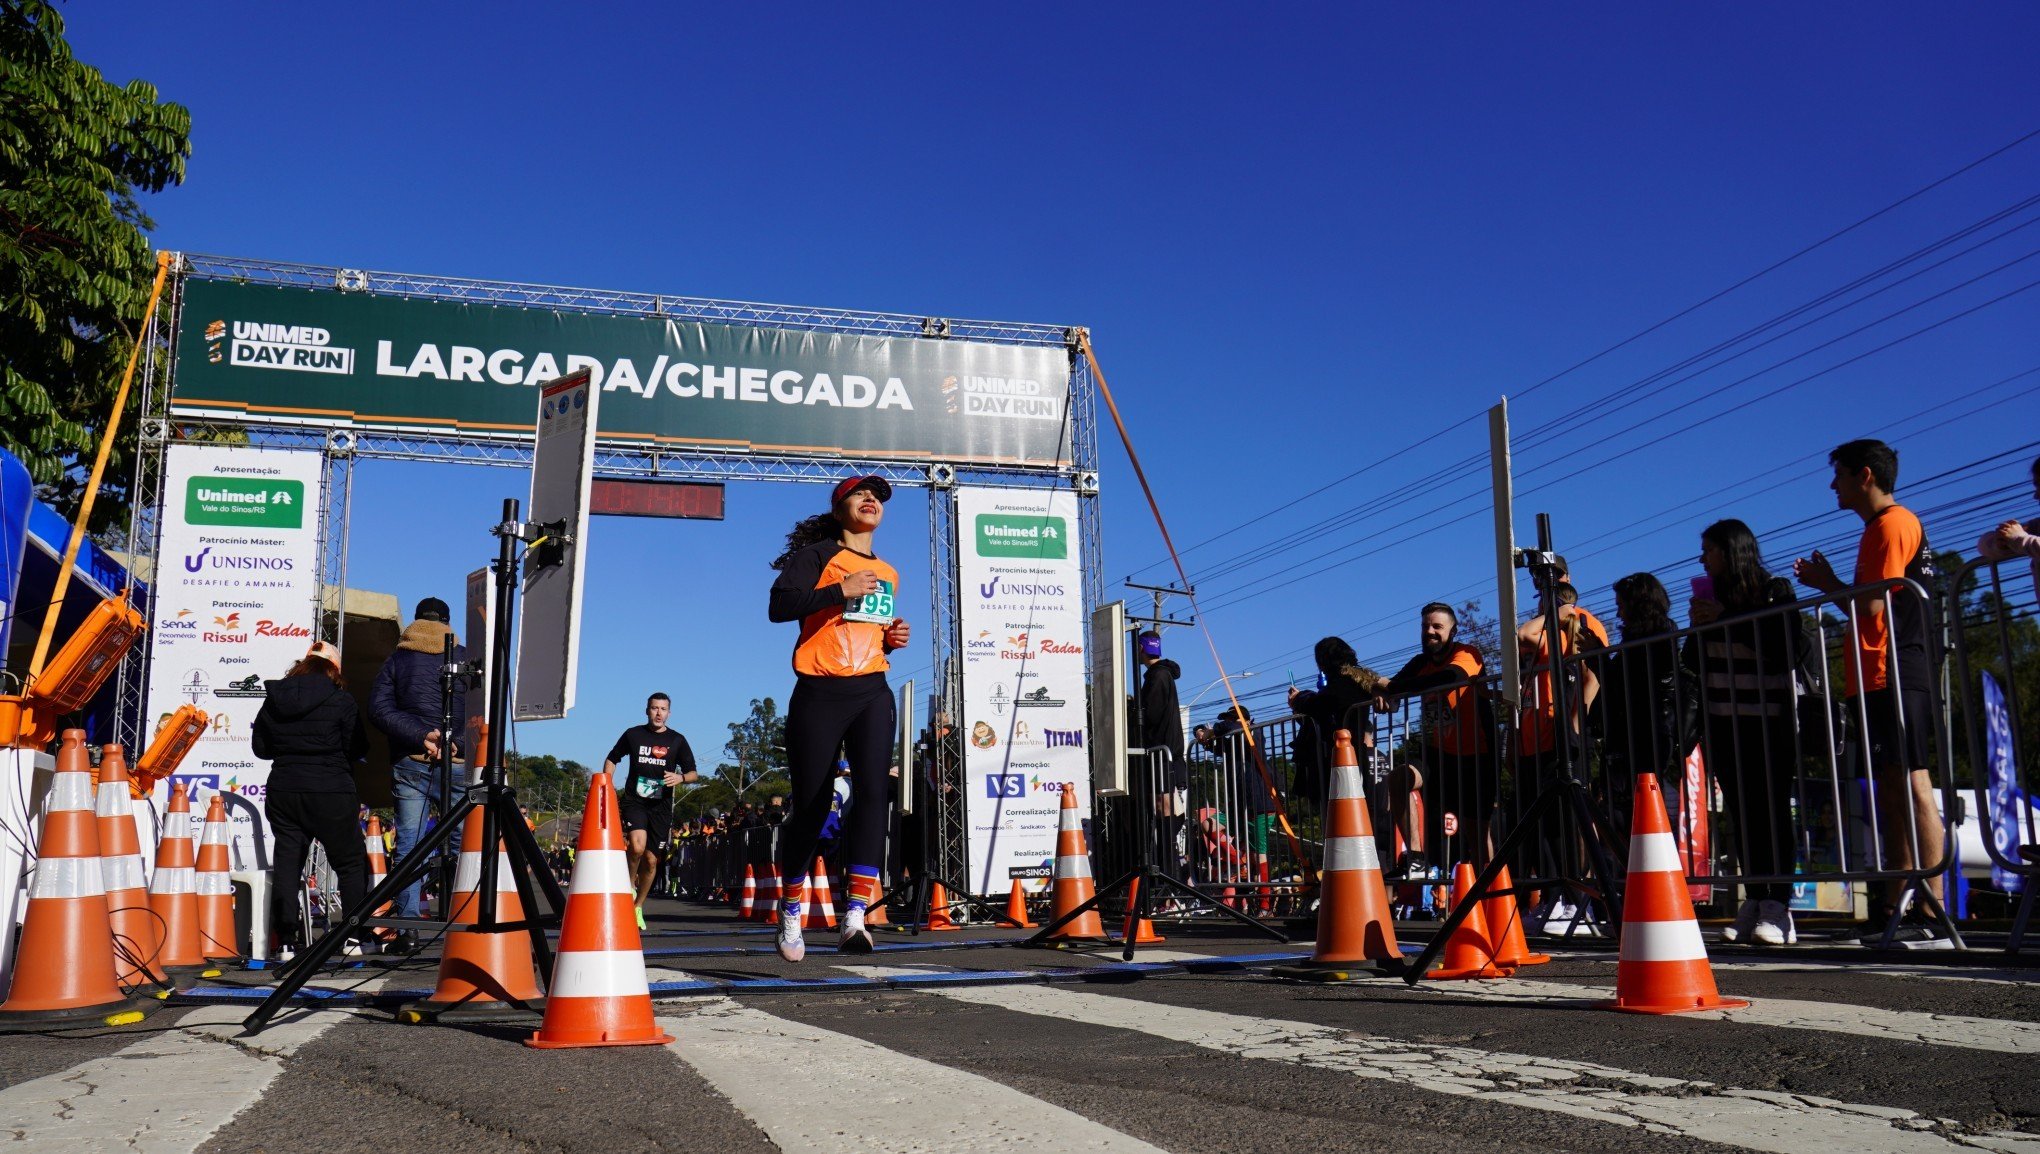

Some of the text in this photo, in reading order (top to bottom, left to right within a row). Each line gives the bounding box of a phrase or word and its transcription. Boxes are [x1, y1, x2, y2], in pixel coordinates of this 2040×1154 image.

[233, 321, 330, 346] UNIMED
[237, 344, 343, 369] DAY RUN
[376, 340, 914, 411] LARGADA/CHEGADA
[963, 376, 1040, 395] UNIMED
[969, 396, 1053, 415] DAY RUN
[213, 465, 281, 475] Apresentação:
[197, 489, 267, 503] Unimed
[220, 505, 230, 513] do
[231, 506, 266, 514] Sinos/RS
[994, 504, 1047, 512] Apresentação:
[984, 525, 1038, 537] Unimed
[199, 536, 285, 546] Patrocínio Máster:
[212, 556, 293, 571] UNISINOS
[1029, 567, 1056, 575] Máster:
[183, 579, 229, 587] DESAFIE
[1002, 584, 1064, 596] UNISINOS
[212, 600, 264, 609] Patrocínio:
[161, 620, 197, 629] Senac
[255, 620, 311, 638] Radan
[1005, 622, 1045, 630] Patrocínio:
[203, 632, 247, 643] Rissul
[967, 640, 995, 648] Senac
[1040, 639, 1083, 654] Radan
[219, 656, 250, 665] Apoio:
[1001, 651, 1035, 660] Rissul
[1015, 671, 1039, 679] Apoio:
[1044, 728, 1083, 749] TITAN
[640, 746, 652, 756] EU
[201, 760, 254, 770] Promoção:
[638, 756, 666, 766] ESPORTES
[1010, 762, 1050, 770] Promoção:
[991, 776, 1020, 796] VS
[1006, 808, 1058, 816] Correalização:
[1026, 868, 1051, 877] SINOS
